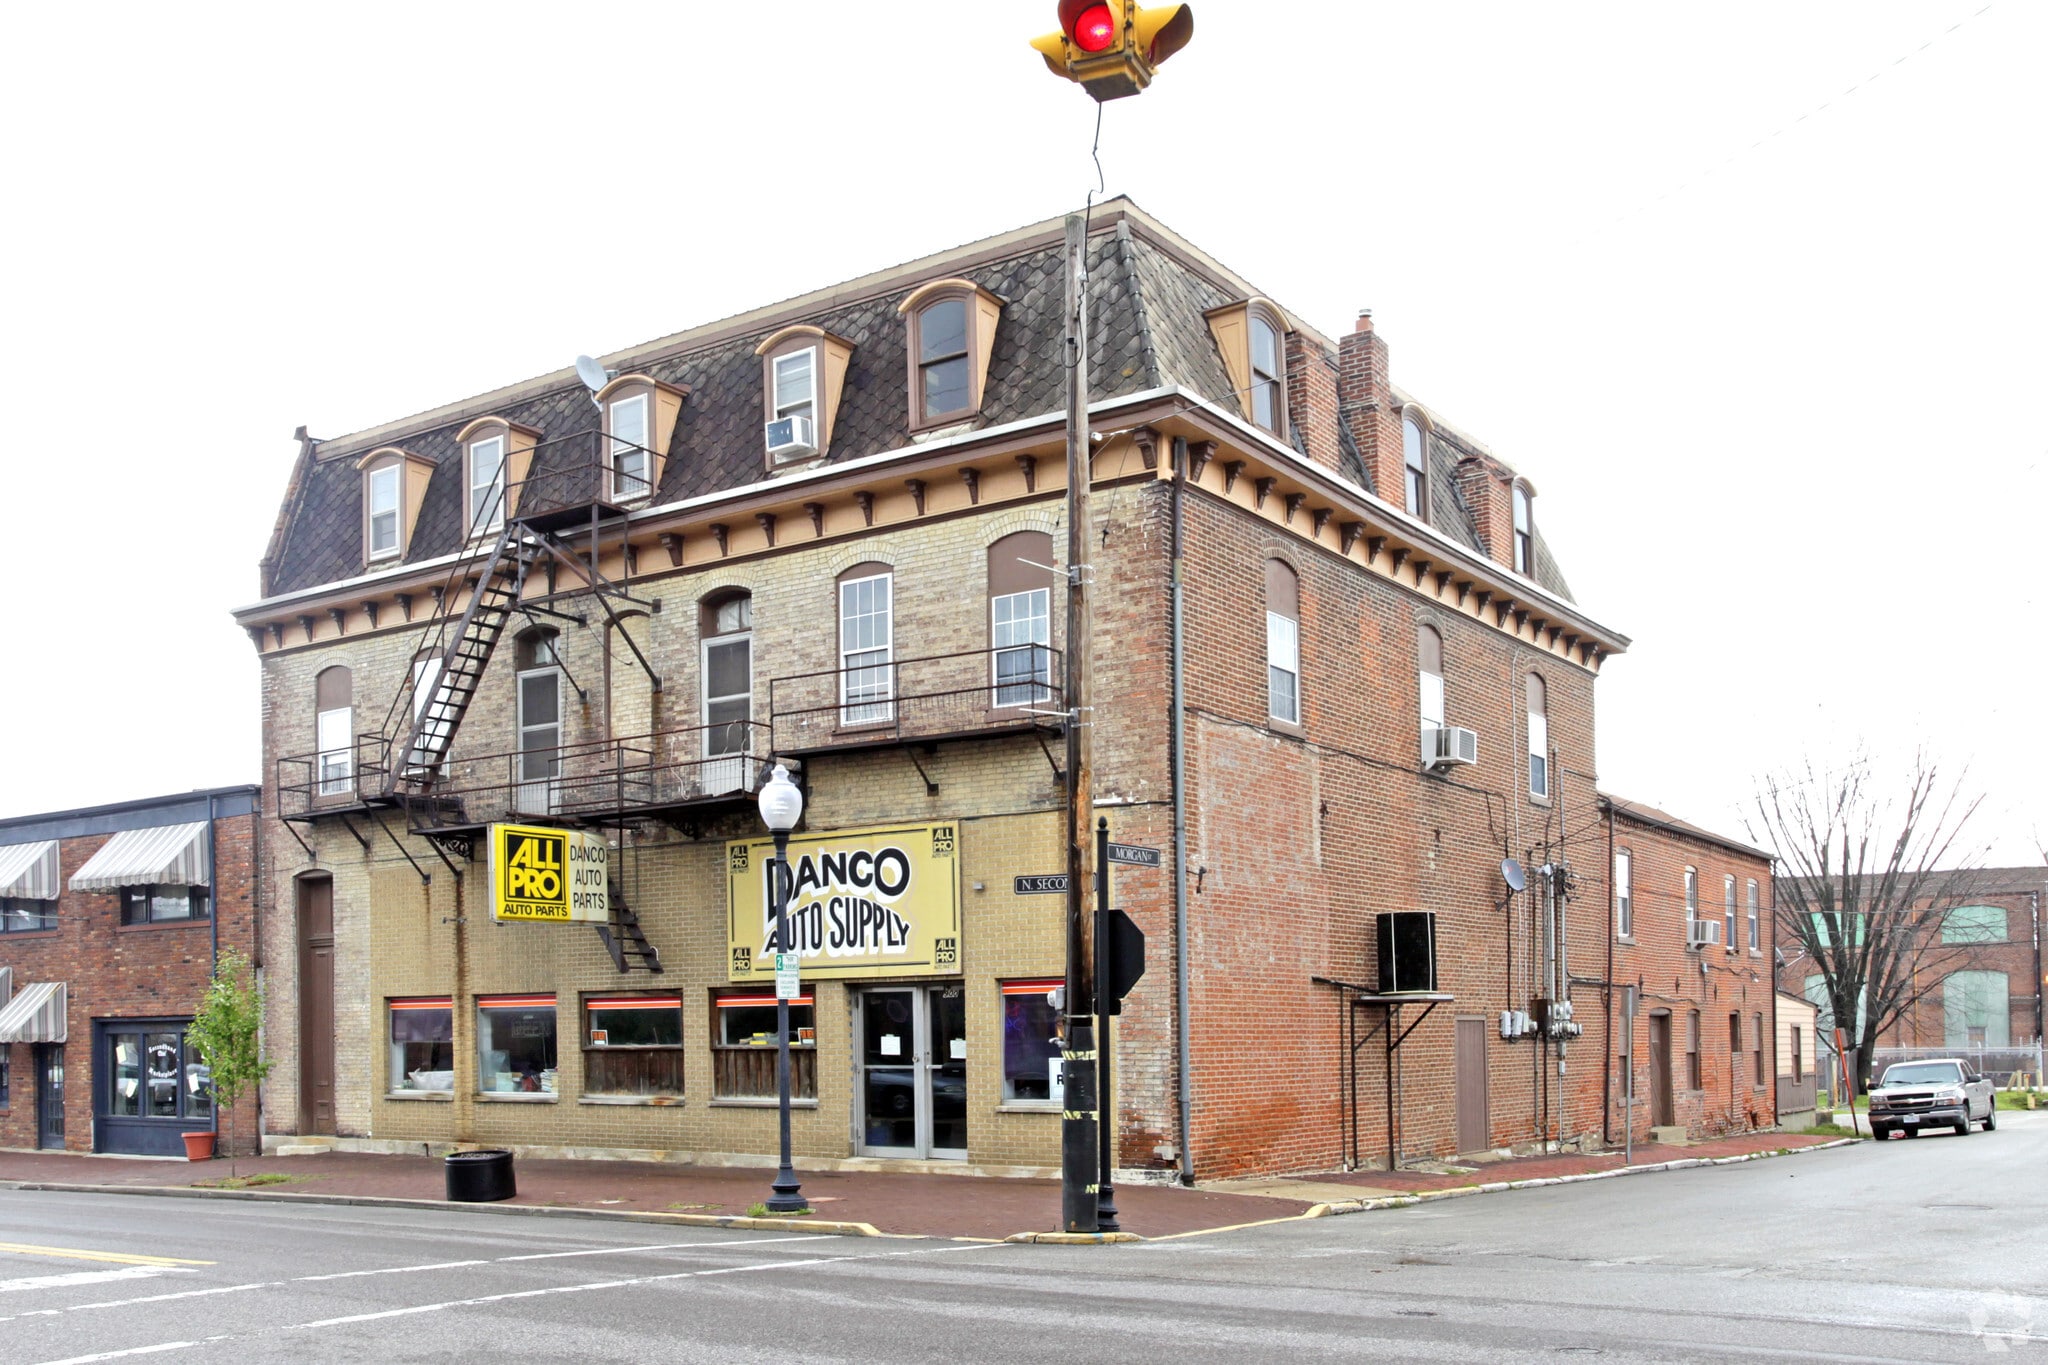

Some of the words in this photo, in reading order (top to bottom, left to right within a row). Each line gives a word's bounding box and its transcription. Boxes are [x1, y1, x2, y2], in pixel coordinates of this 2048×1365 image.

[934, 829, 952, 840] ALL
[731, 846, 748, 857] ALL
[934, 841, 953, 851] PRO
[509, 838, 560, 870] ALL
[570, 845, 605, 863] DANCO
[1115, 847, 1148, 862] MORGAN
[731, 857, 748, 868] PRO
[509, 867, 561, 899] PRO
[575, 869, 602, 887] AUTO
[766, 847, 910, 920] DANCO
[1022, 879, 1033, 890] N.
[1037, 877, 1068, 890] SECO
[573, 892, 605, 910] PARTS
[504, 904, 532, 915] AUTO
[536, 905, 568, 917] PARTS
[829, 896, 910, 950] SUPPLY
[937, 939, 955, 950] ALL
[734, 948, 750, 958] ALL
[936, 951, 955, 962] PRO
[733, 959, 750, 970] PRO
[776, 956, 782, 969] 2
